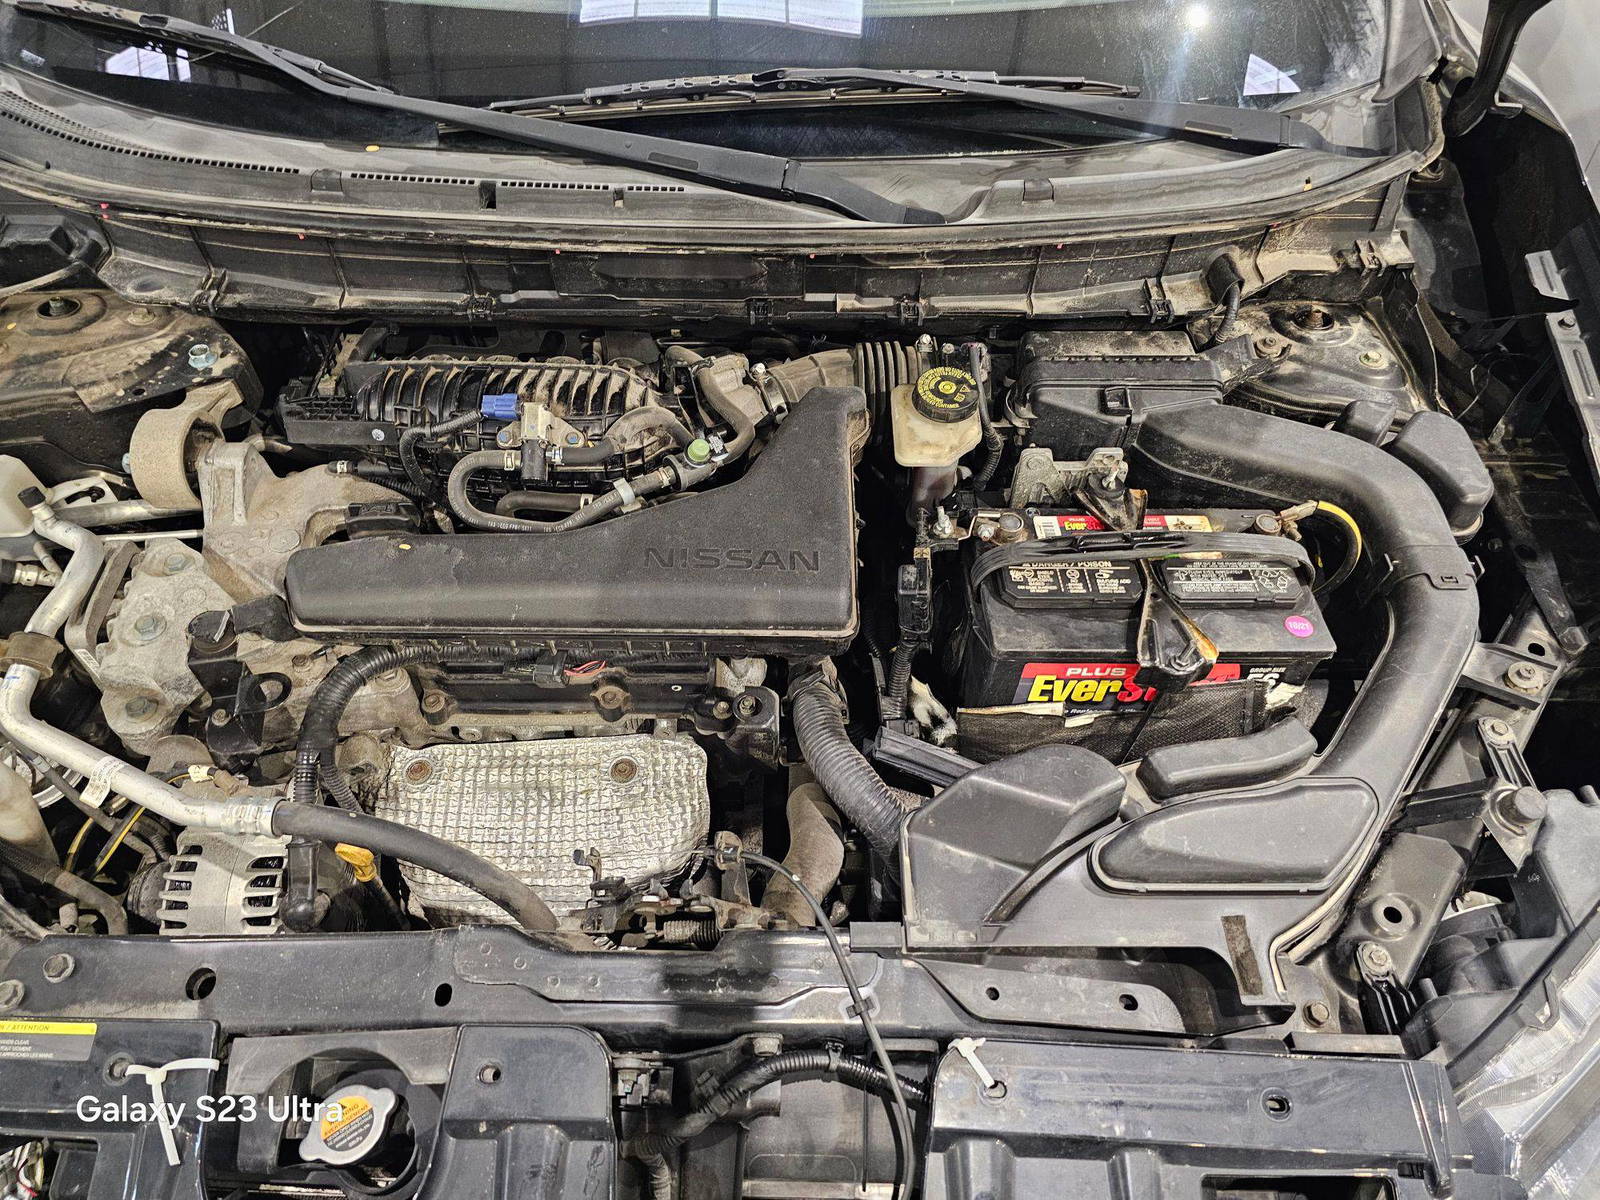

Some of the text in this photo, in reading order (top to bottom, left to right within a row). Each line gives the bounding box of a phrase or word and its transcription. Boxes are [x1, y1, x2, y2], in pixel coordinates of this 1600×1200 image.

[645, 547, 820, 571] NISSAN
[1066, 667, 1127, 677] PLUS
[12, 1024, 49, 1032] ATTENTION
